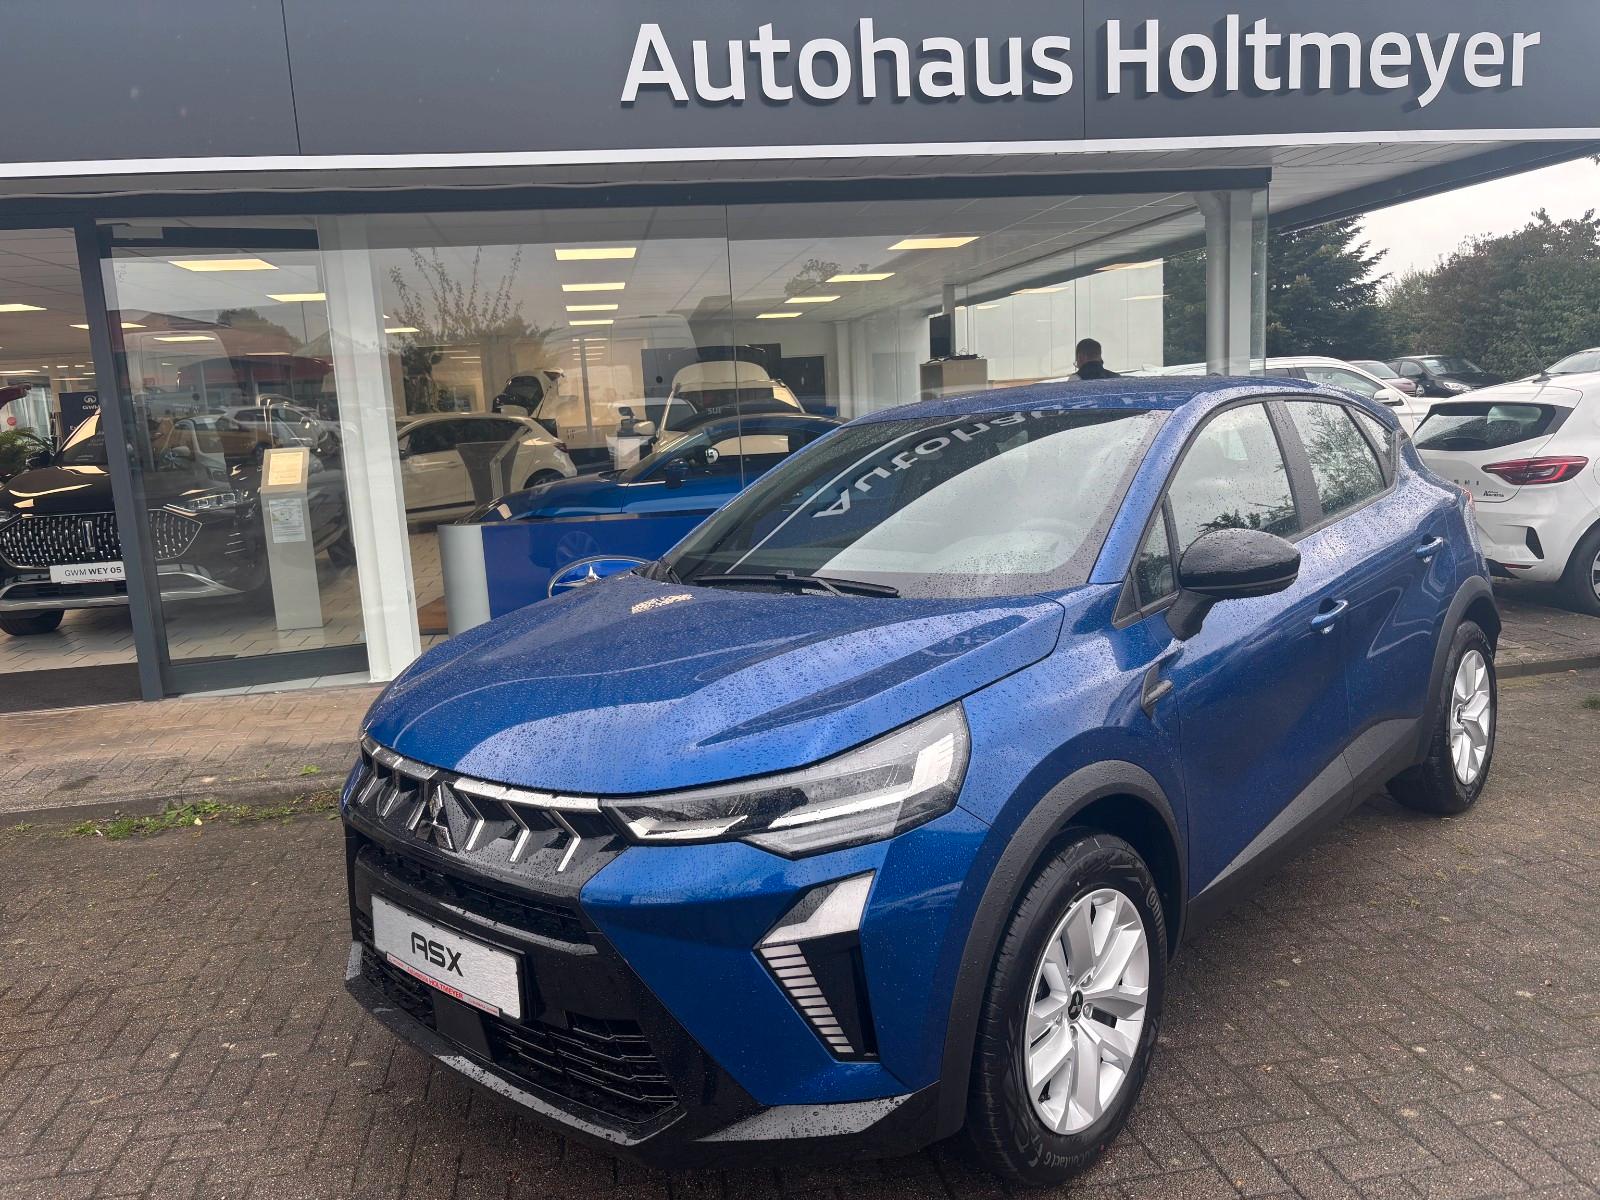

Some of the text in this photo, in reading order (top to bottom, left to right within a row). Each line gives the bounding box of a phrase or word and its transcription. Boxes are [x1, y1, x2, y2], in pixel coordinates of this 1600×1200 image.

[620, 14, 1541, 108] Autohaus Holtmeyer
[64, 566, 122, 577] GWM WEY 05
[411, 931, 464, 978] ASX
